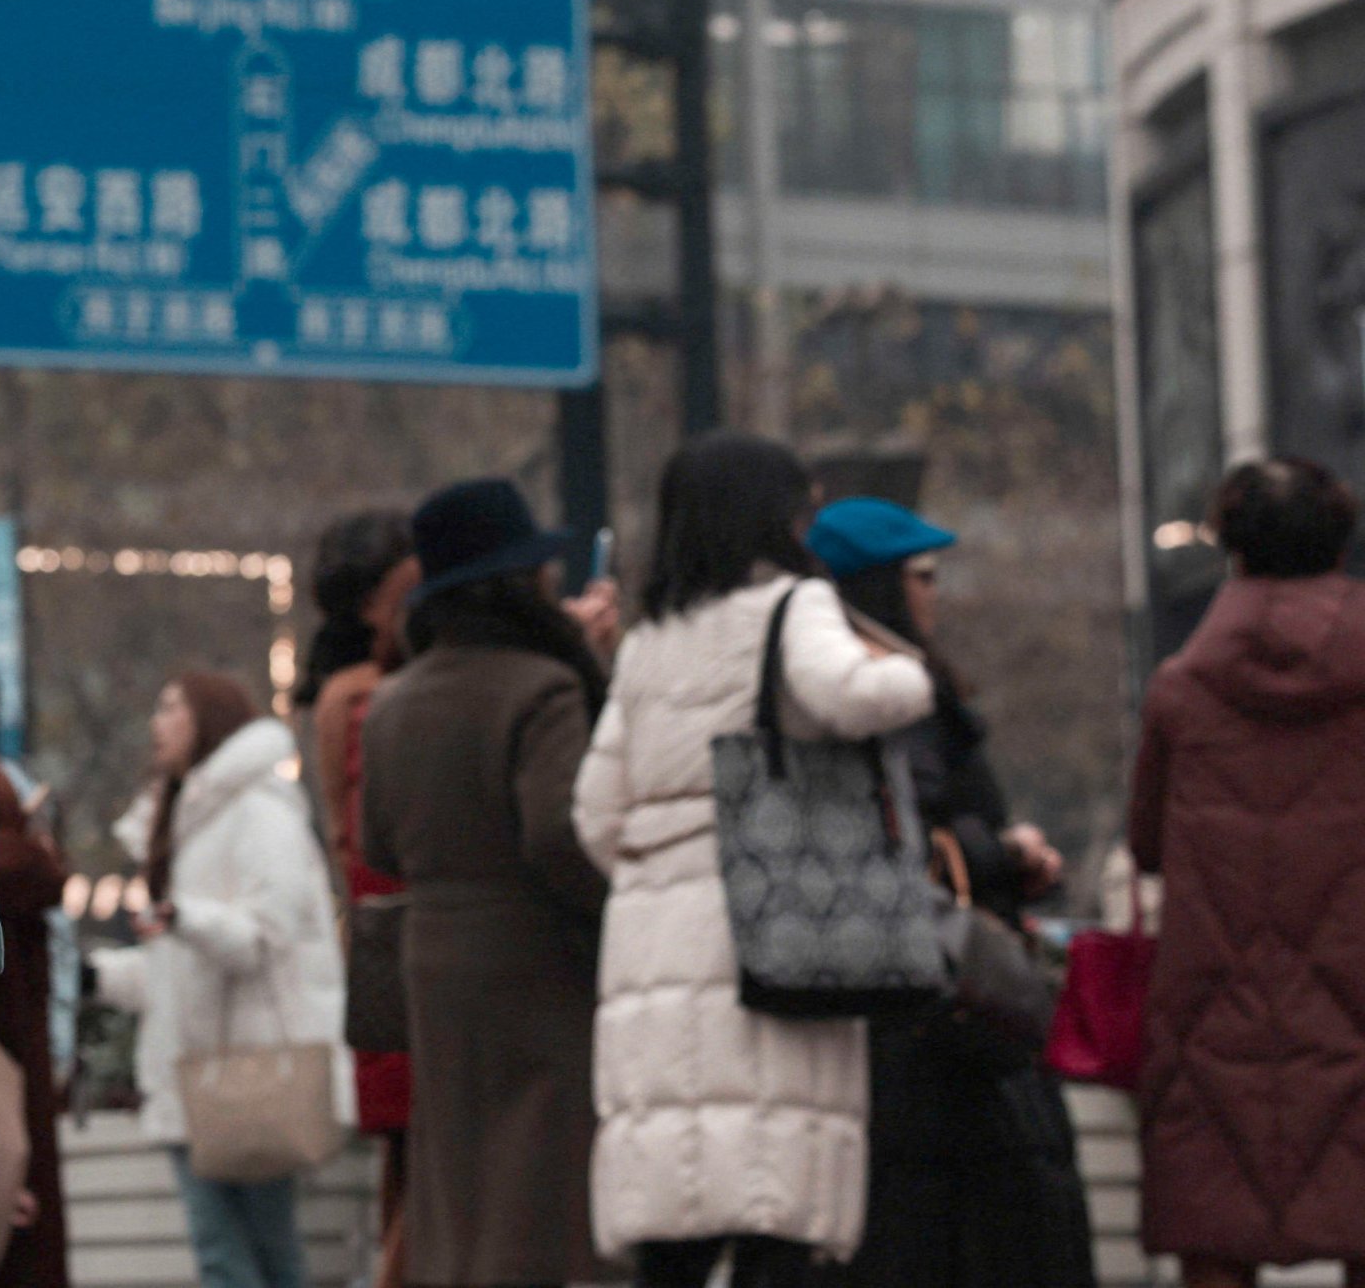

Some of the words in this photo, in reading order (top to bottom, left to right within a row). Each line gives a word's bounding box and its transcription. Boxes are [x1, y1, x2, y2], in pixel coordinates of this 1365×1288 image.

[358, 34, 567, 110] 成都北路
[361, 179, 570, 250] 成都北路
